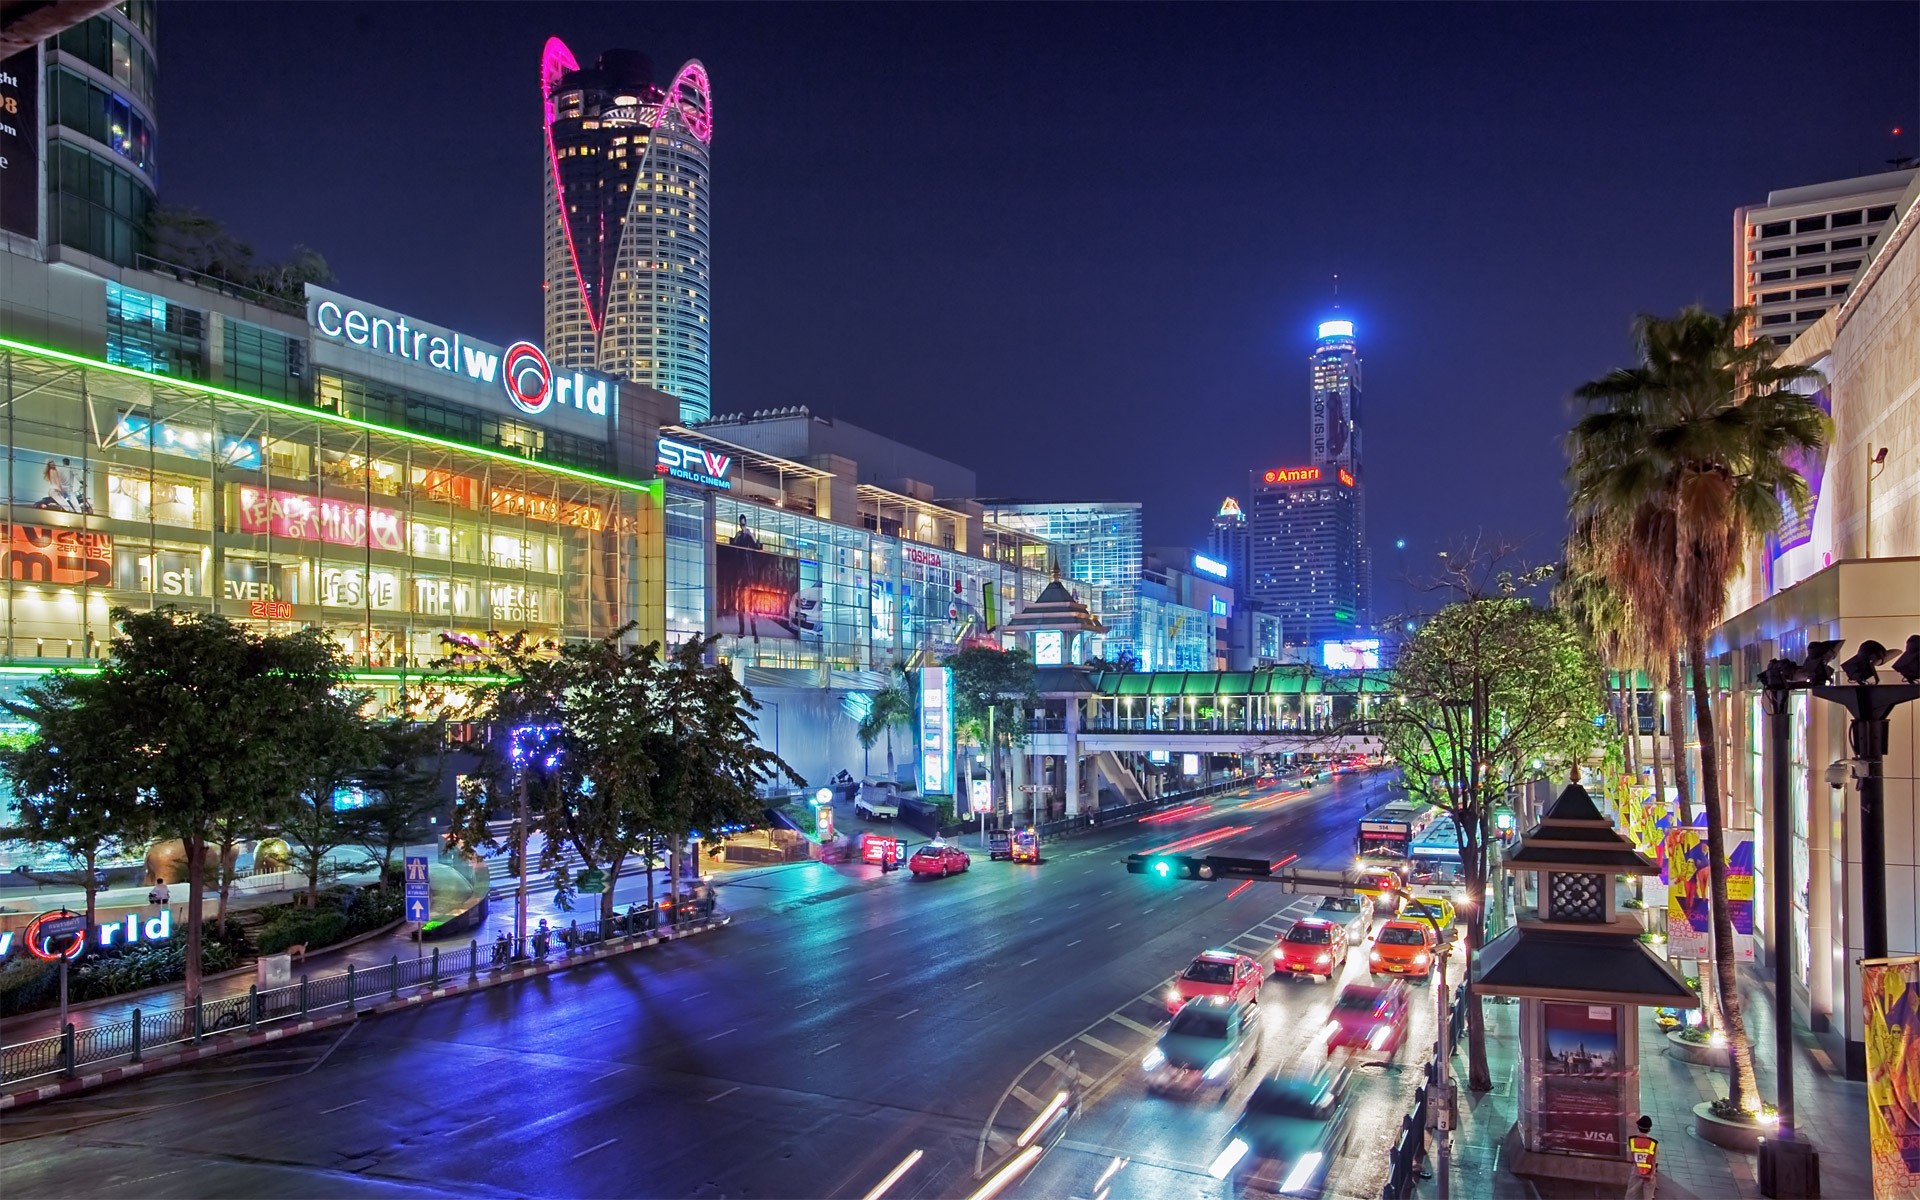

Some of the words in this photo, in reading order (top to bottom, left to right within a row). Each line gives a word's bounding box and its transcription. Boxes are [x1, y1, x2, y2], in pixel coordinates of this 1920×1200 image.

[658, 439, 731, 478] SFW
[669, 467, 699, 482] WORLD
[700, 475, 731, 490] CINEMA
[1277, 468, 1319, 482] Amari
[906, 548, 941, 567] TOSHIBA
[223, 580, 276, 602] EVER
[416, 579, 470, 618] TREND
[490, 584, 539, 609] MEGA
[251, 600, 292, 619] ZEN
[493, 606, 539, 623] STORE
[1584, 1130, 1614, 1142] VISA
